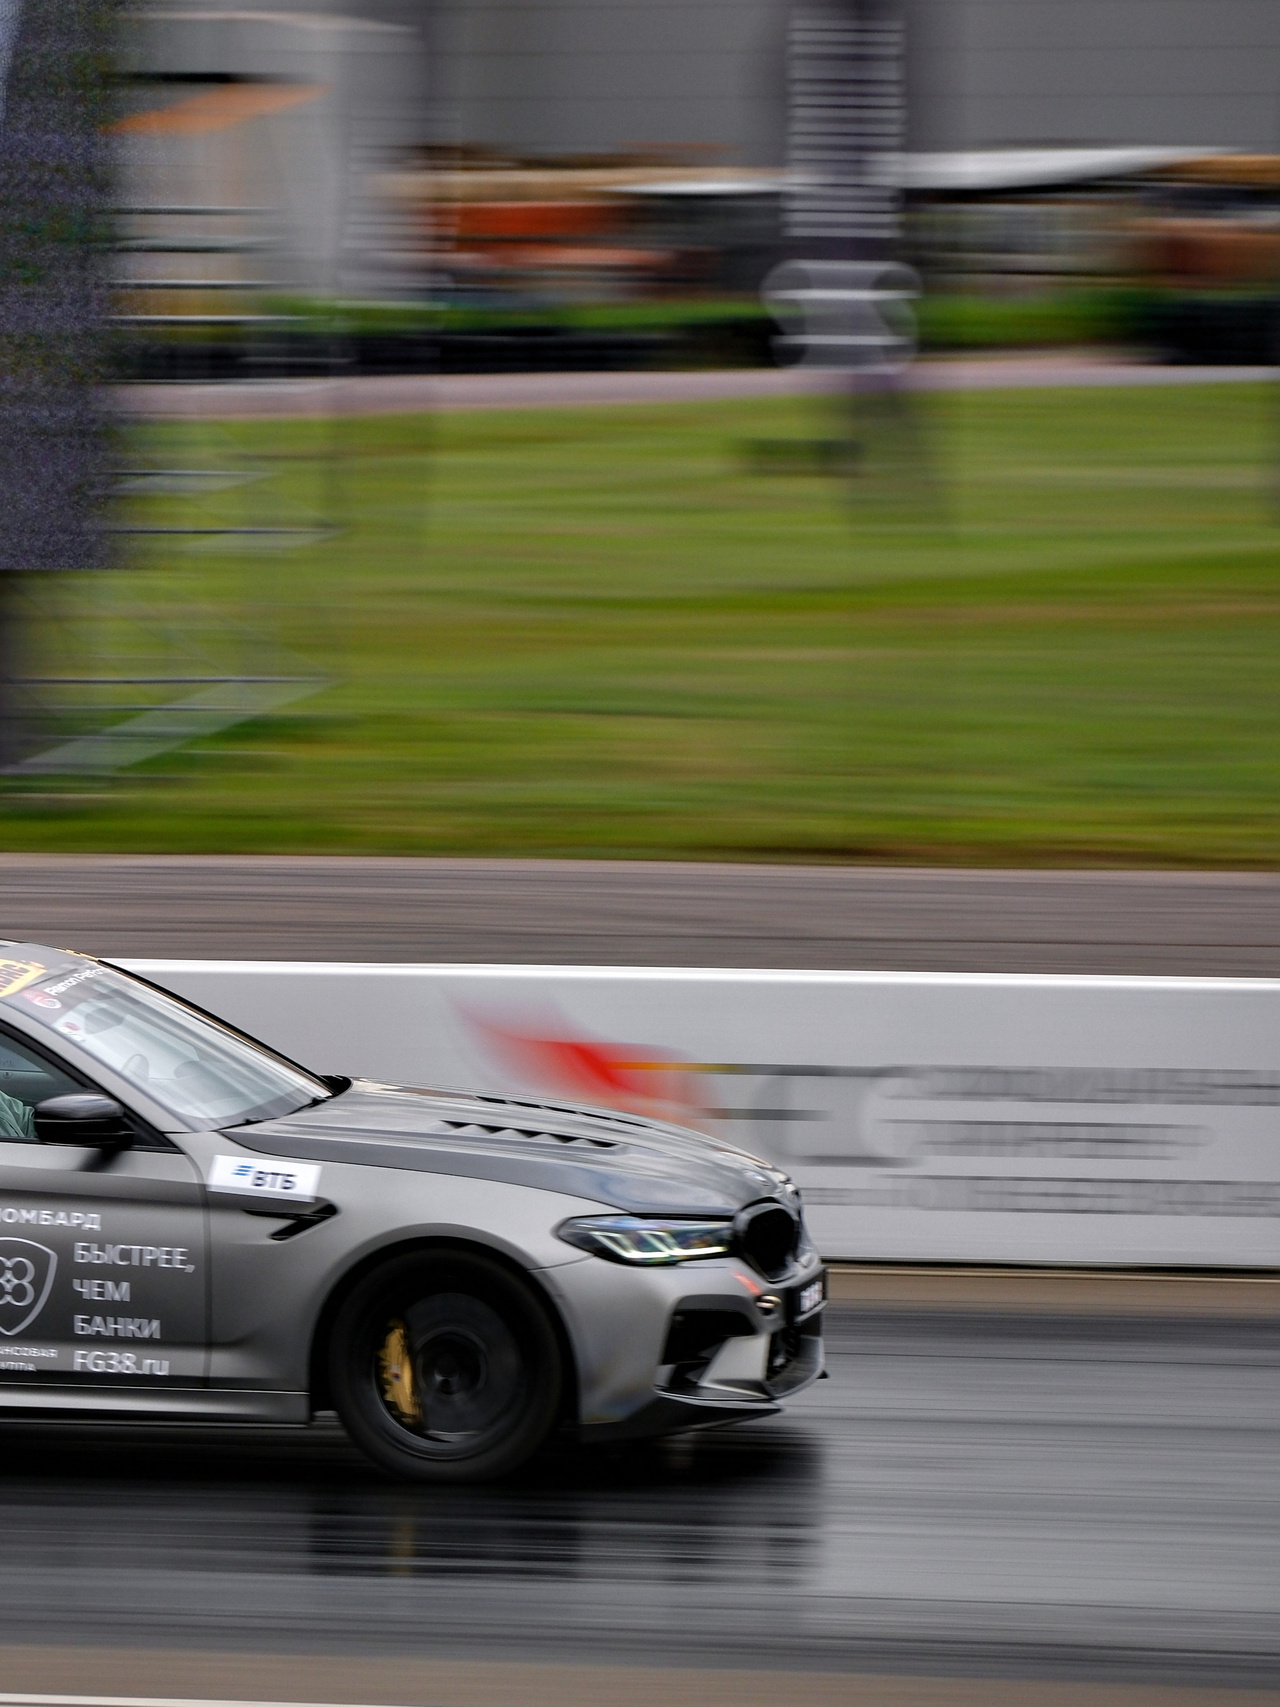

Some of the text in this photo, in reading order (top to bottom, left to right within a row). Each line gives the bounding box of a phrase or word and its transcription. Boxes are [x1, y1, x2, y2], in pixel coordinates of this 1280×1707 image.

[251, 1170, 298, 1190] ВТБ
[73, 1242, 196, 1273] БЫСТРЕЕ,
[72, 1278, 131, 1302] ЧЕМ
[73, 1314, 161, 1339] БАНКИ
[72, 1350, 170, 1376] FG38.ru
